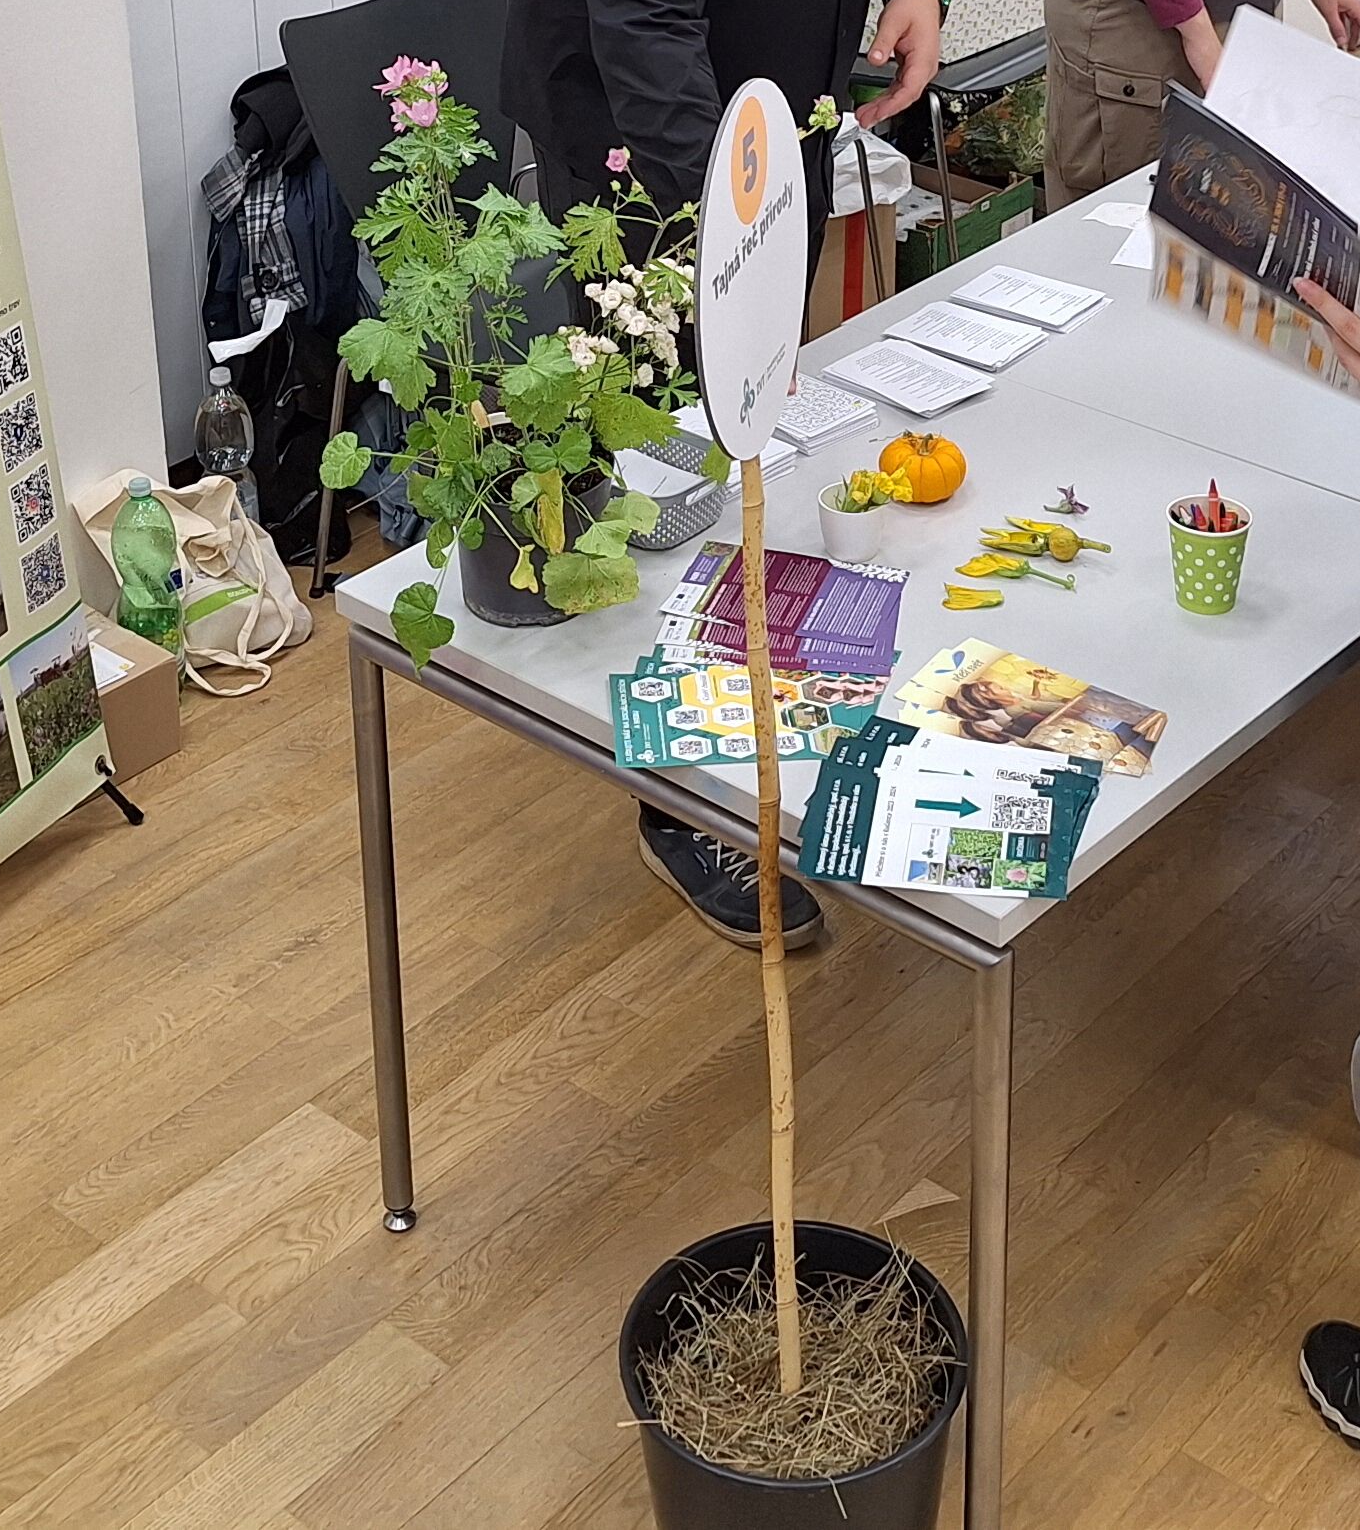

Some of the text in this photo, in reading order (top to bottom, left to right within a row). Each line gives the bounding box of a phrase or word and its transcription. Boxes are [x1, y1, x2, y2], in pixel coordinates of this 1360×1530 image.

[742, 125, 758, 193] 5
[712, 181, 794, 301] Tajná řeč přírody
